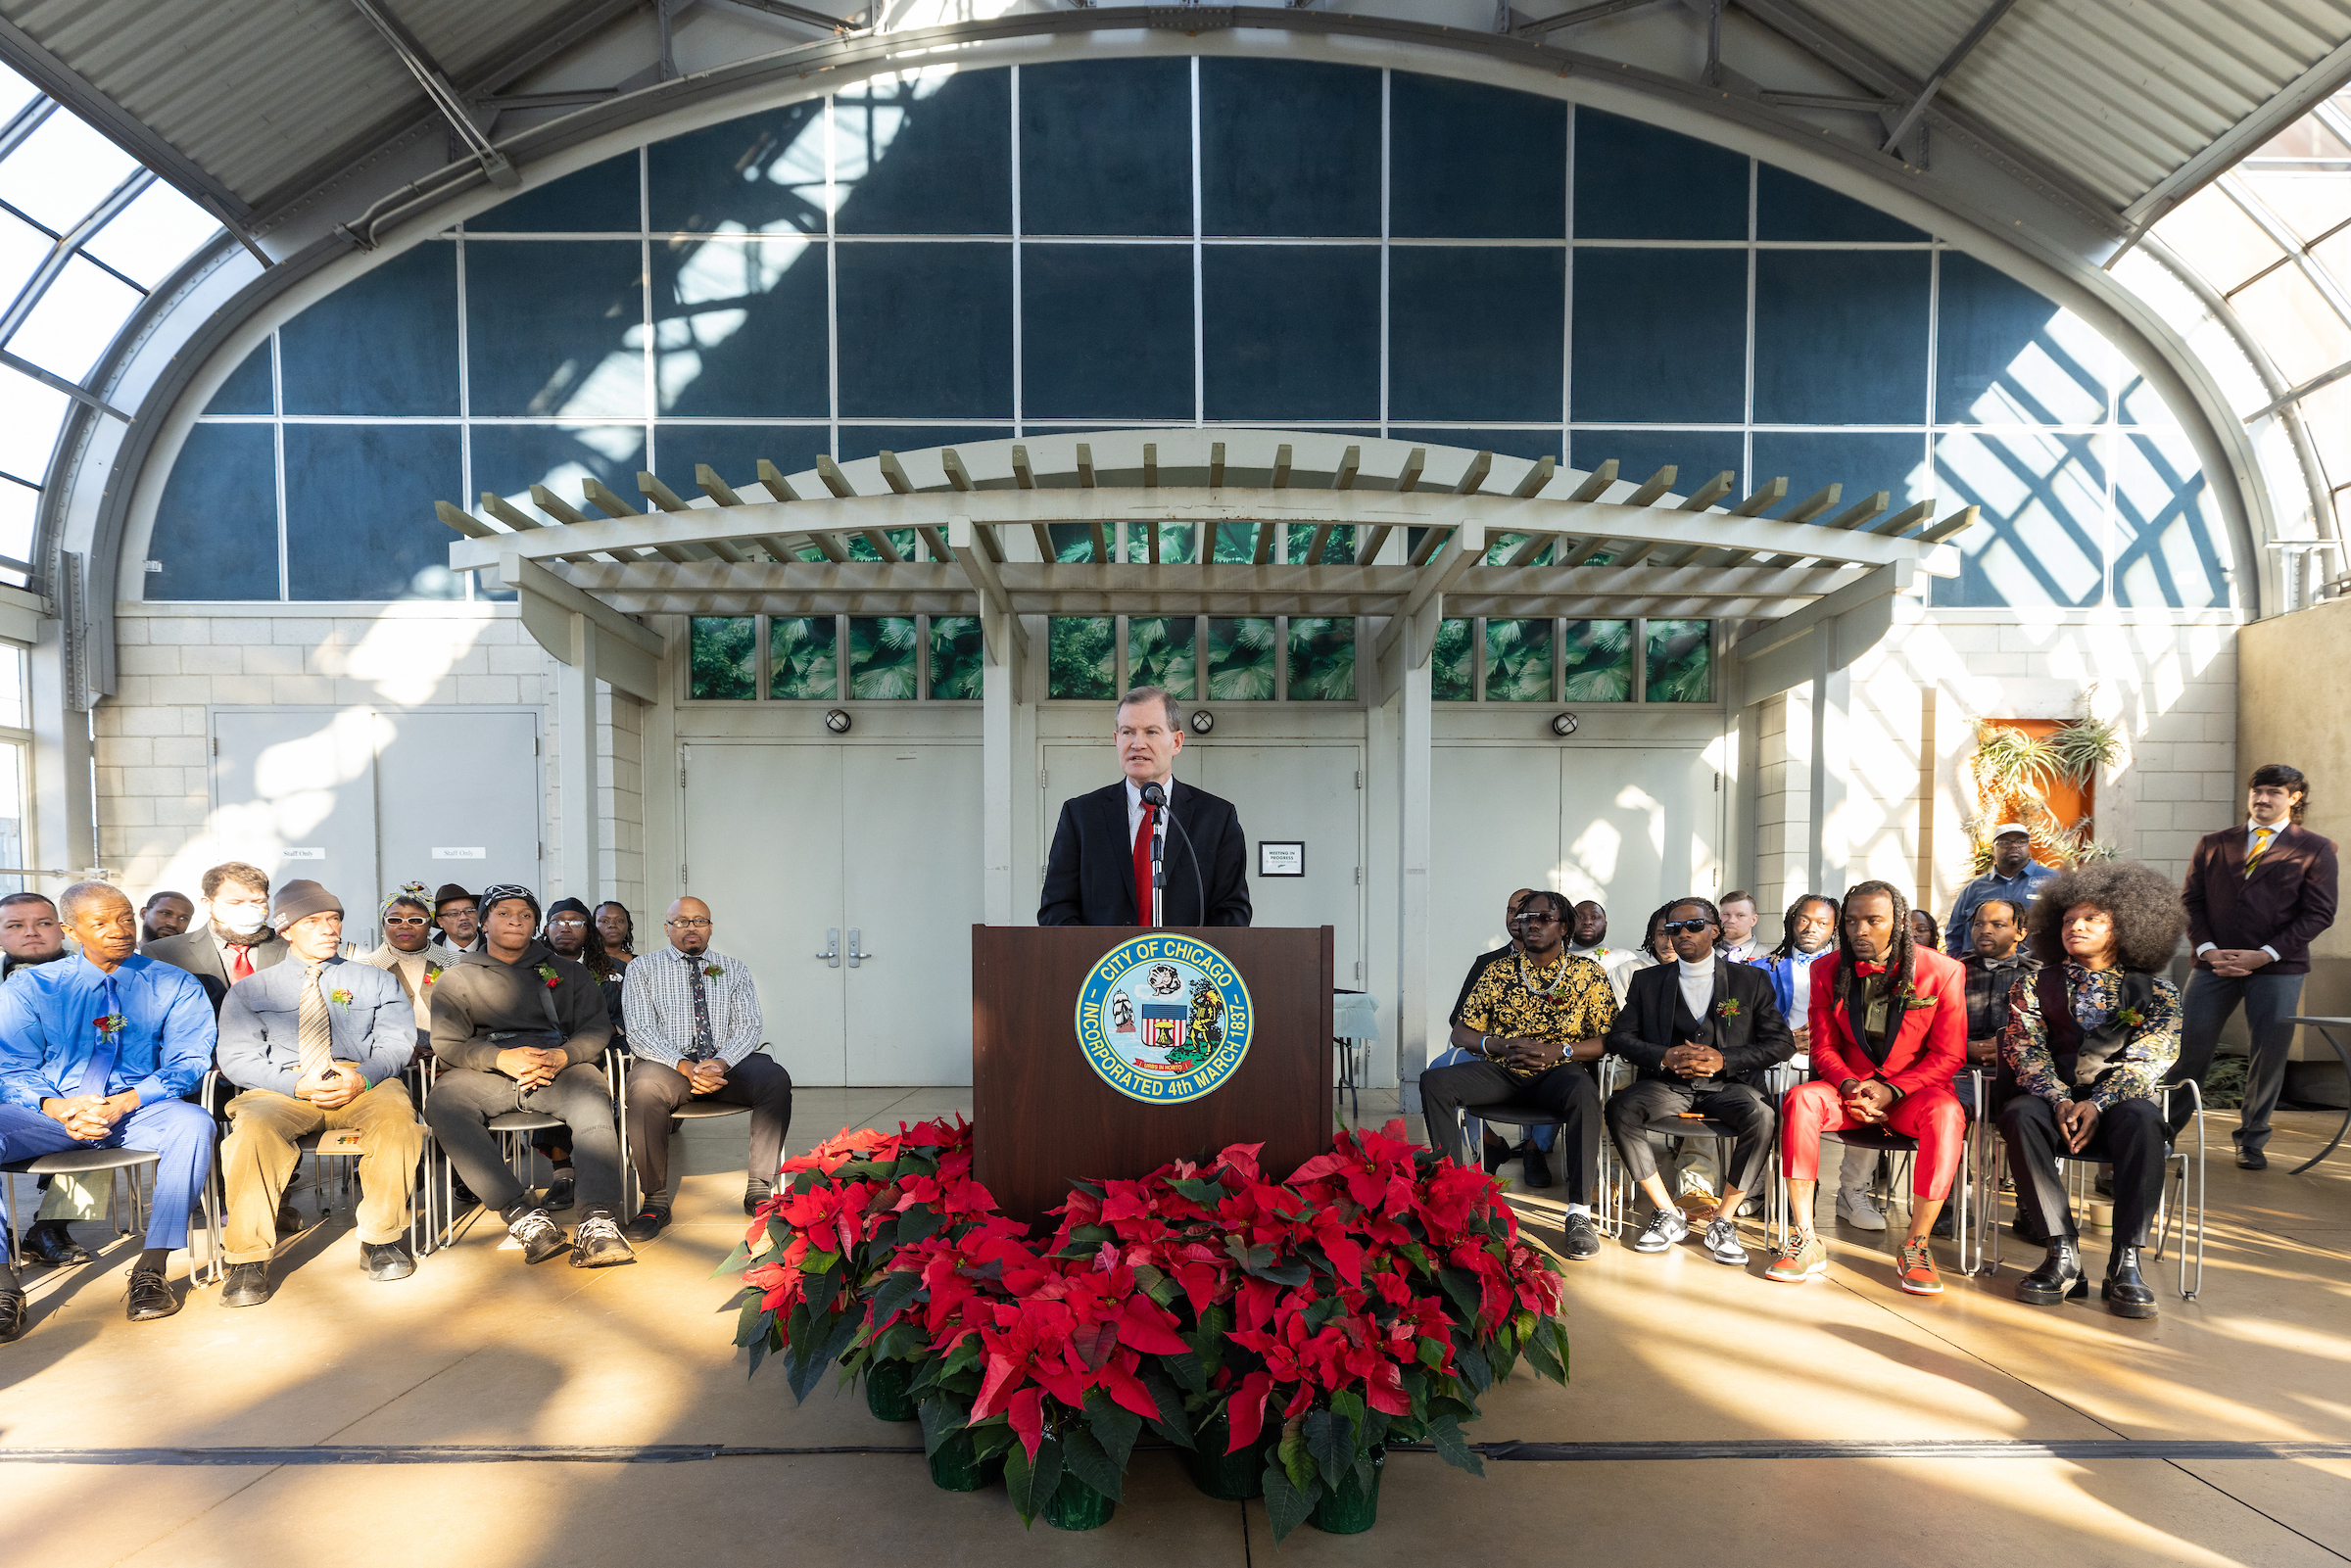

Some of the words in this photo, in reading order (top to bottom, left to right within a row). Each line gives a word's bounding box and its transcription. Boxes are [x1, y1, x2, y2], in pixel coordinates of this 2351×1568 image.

[1100, 949, 1133, 981] CITY
[1136, 941, 1159, 959] OF
[1164, 941, 1233, 987] CHICAGO
[1082, 1002, 1164, 1096] INCORPORATED
[1168, 1080, 1193, 1096] 4th
[1194, 1040, 1241, 1089] MARCH
[1229, 1004, 1246, 1038] 1837
